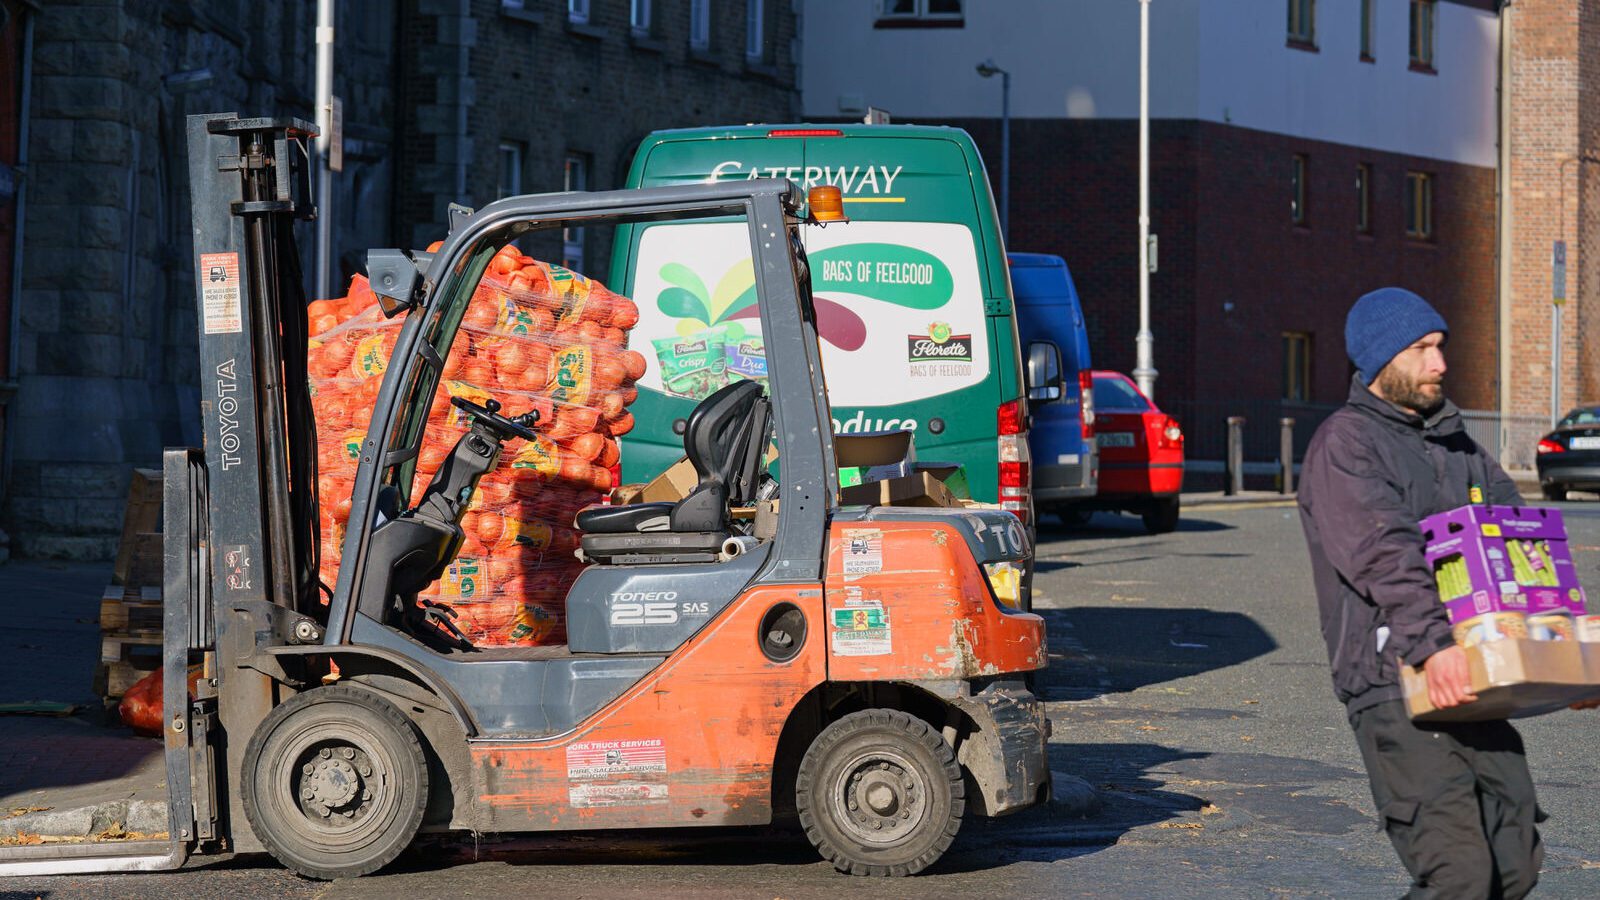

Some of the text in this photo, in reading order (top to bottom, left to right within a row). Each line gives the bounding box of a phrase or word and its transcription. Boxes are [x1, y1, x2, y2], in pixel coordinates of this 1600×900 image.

[823, 260, 933, 285] BAGS OF FEELGOOD
[912, 339, 968, 358] Florette
[679, 357, 707, 371] Crispy
[742, 356, 764, 370] Duo
[910, 364, 972, 377] BAGS OF FEELGOOD
[216, 358, 241, 471] TOYOTA
[611, 591, 678, 602] TONERO
[611, 602, 709, 626] 25 SAS
[591, 741, 620, 749] TRUCK
[620, 739, 662, 748] SERVICES
[628, 764, 665, 773] SERVICE
